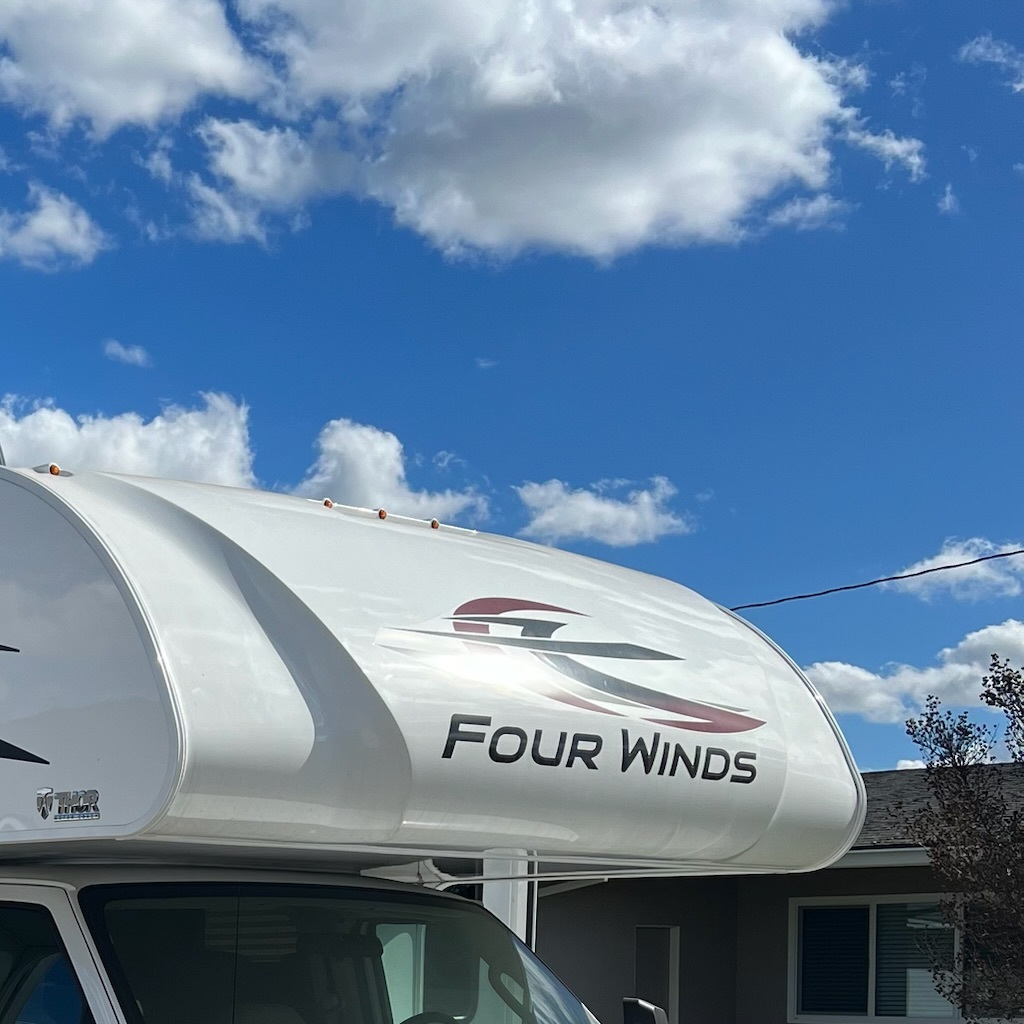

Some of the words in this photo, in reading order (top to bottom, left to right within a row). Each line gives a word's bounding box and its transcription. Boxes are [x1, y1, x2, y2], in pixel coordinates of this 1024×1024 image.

[441, 713, 603, 771] FOUR
[621, 728, 757, 784] WINDS
[54, 790, 100, 814] THOR
